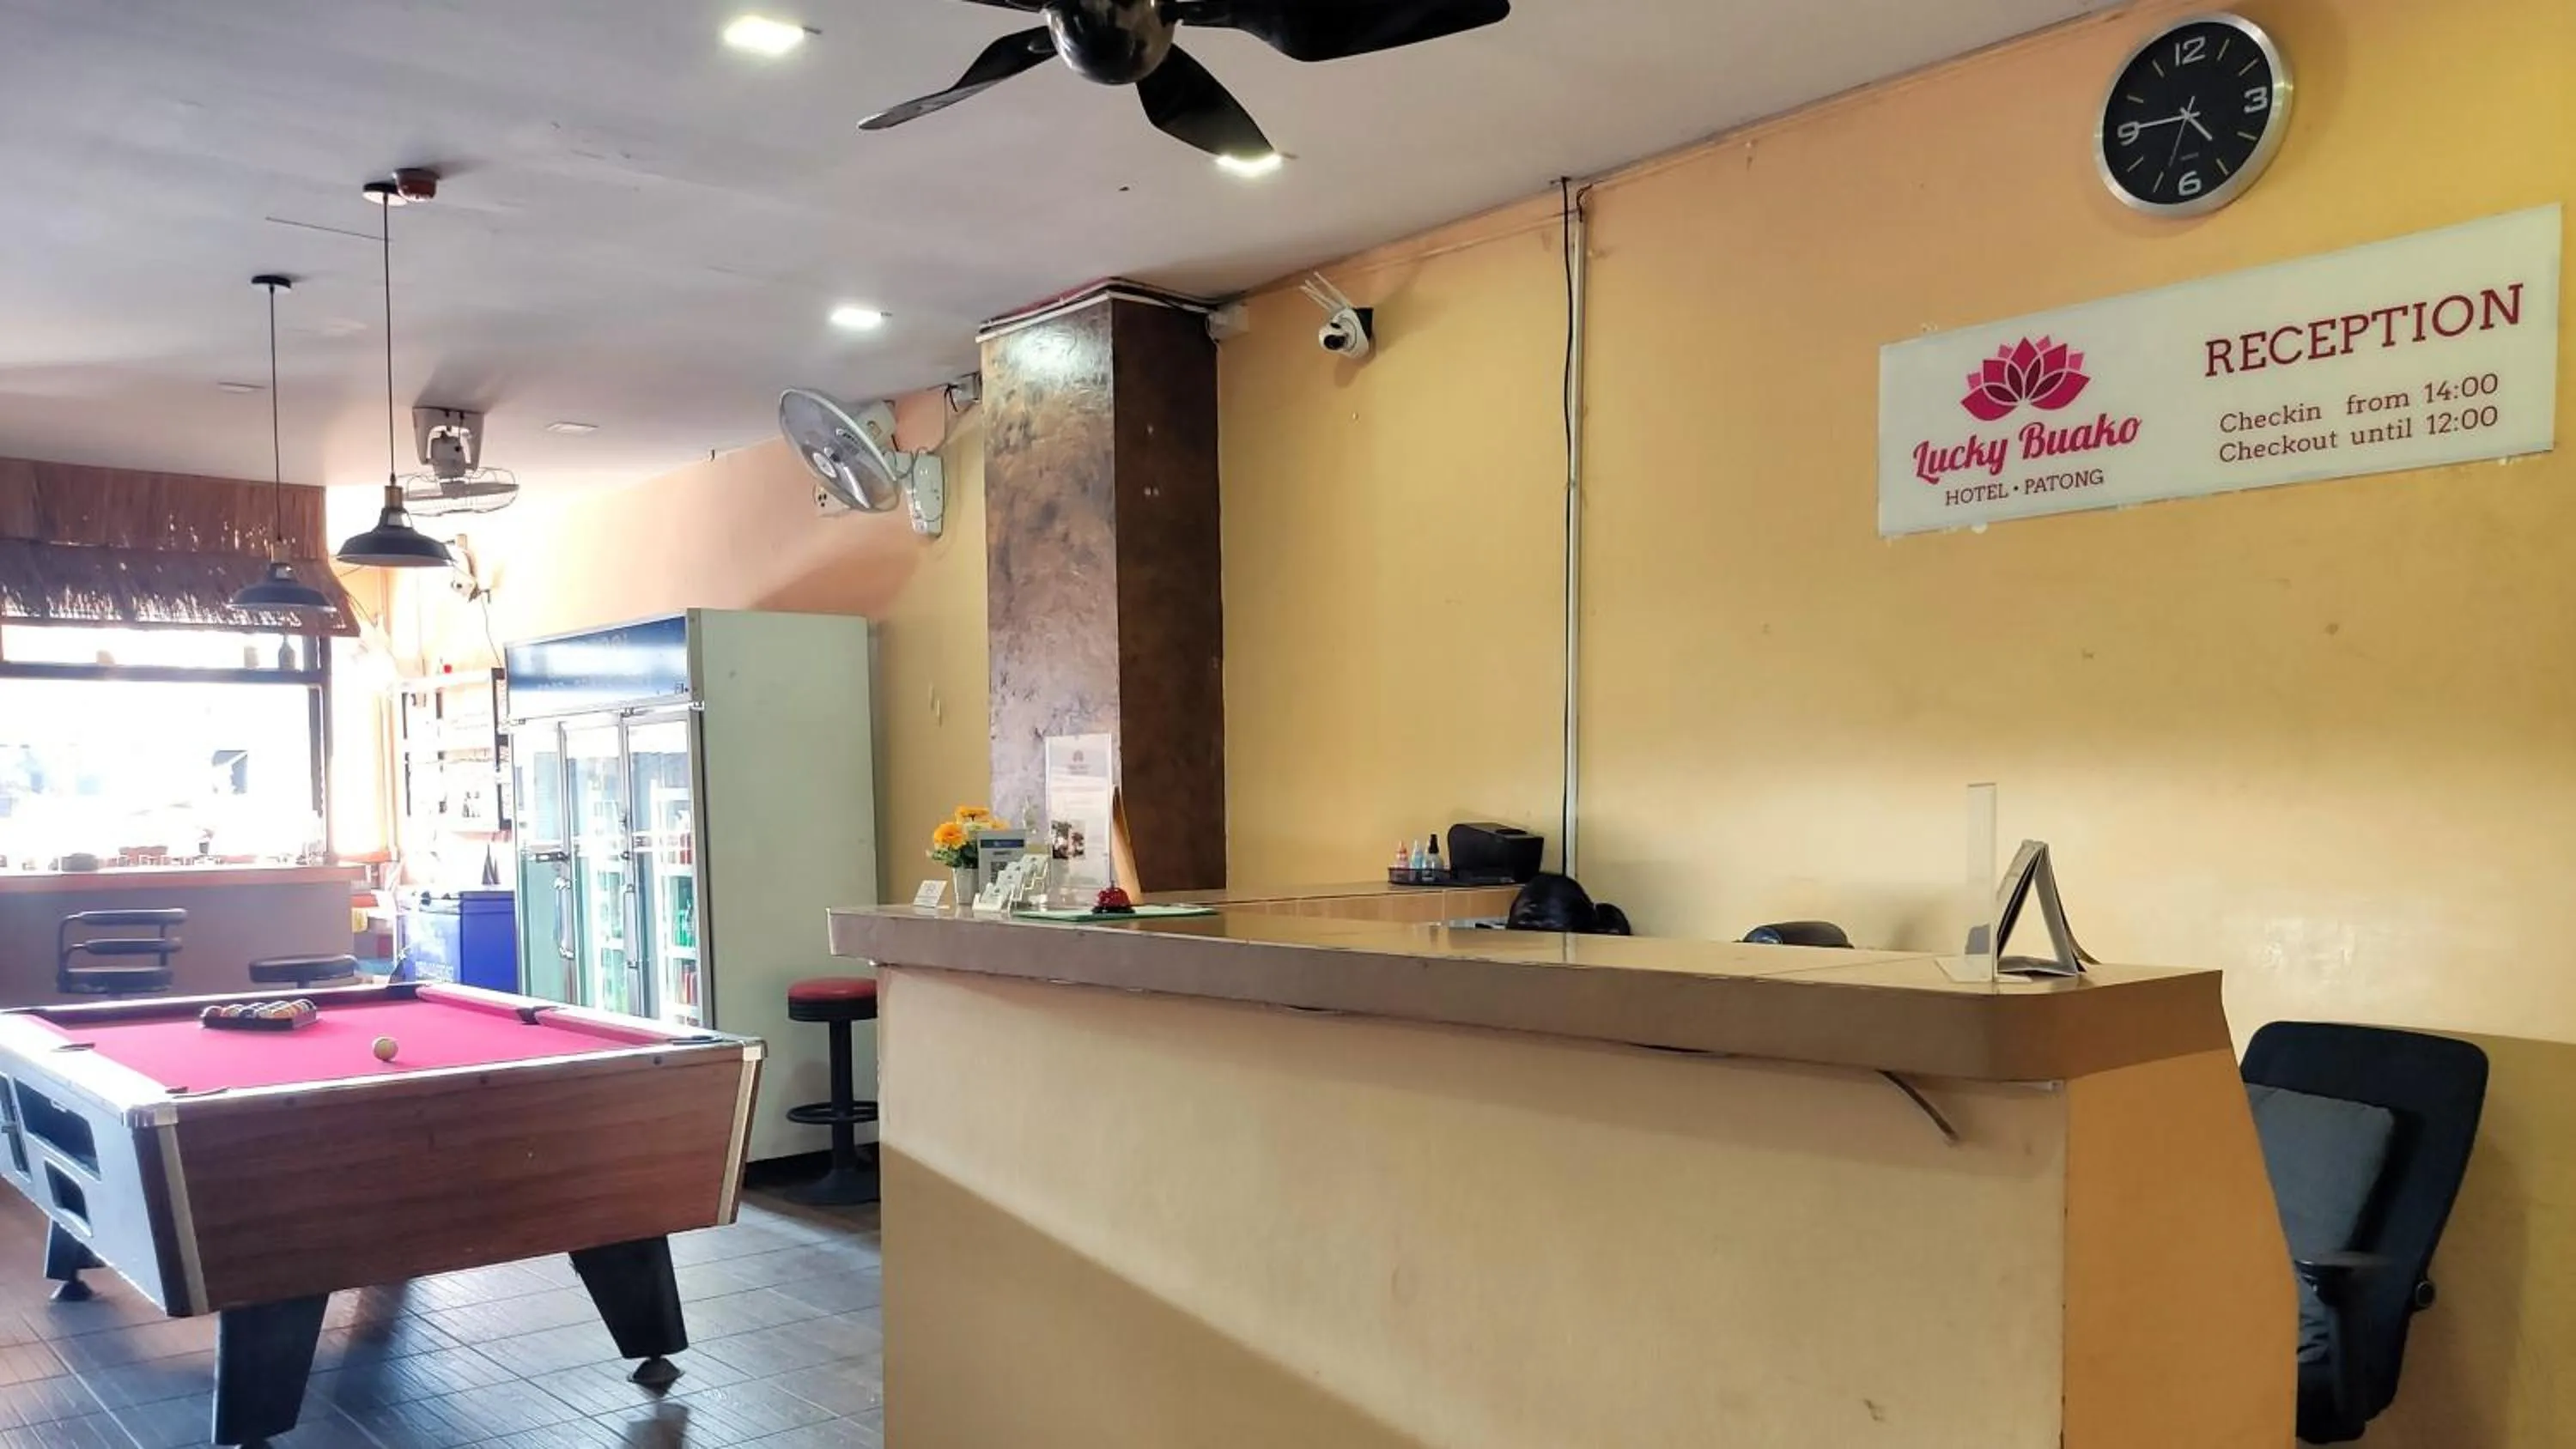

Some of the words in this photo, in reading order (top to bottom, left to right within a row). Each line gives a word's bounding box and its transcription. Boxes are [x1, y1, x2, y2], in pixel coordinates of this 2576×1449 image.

[2174, 36, 2206, 67] 12
[2243, 86, 2269, 115] 3
[2117, 120, 2141, 147] 9
[2178, 171, 2202, 197] 6
[2204, 282, 2524, 379] RECEPTION
[2219, 404, 2323, 433] Checkin
[2346, 391, 2411, 416] from
[2424, 372, 2499, 404] 14:00
[1912, 433, 2009, 486] Lucky
[2018, 412, 2143, 461] Buako
[2219, 430, 2338, 464] Checkout
[2349, 417, 2413, 446] until
[2426, 404, 2499, 436] 12:00
[1945, 482, 2009, 506] HOTEL
[2024, 468, 2105, 495] PATONG
